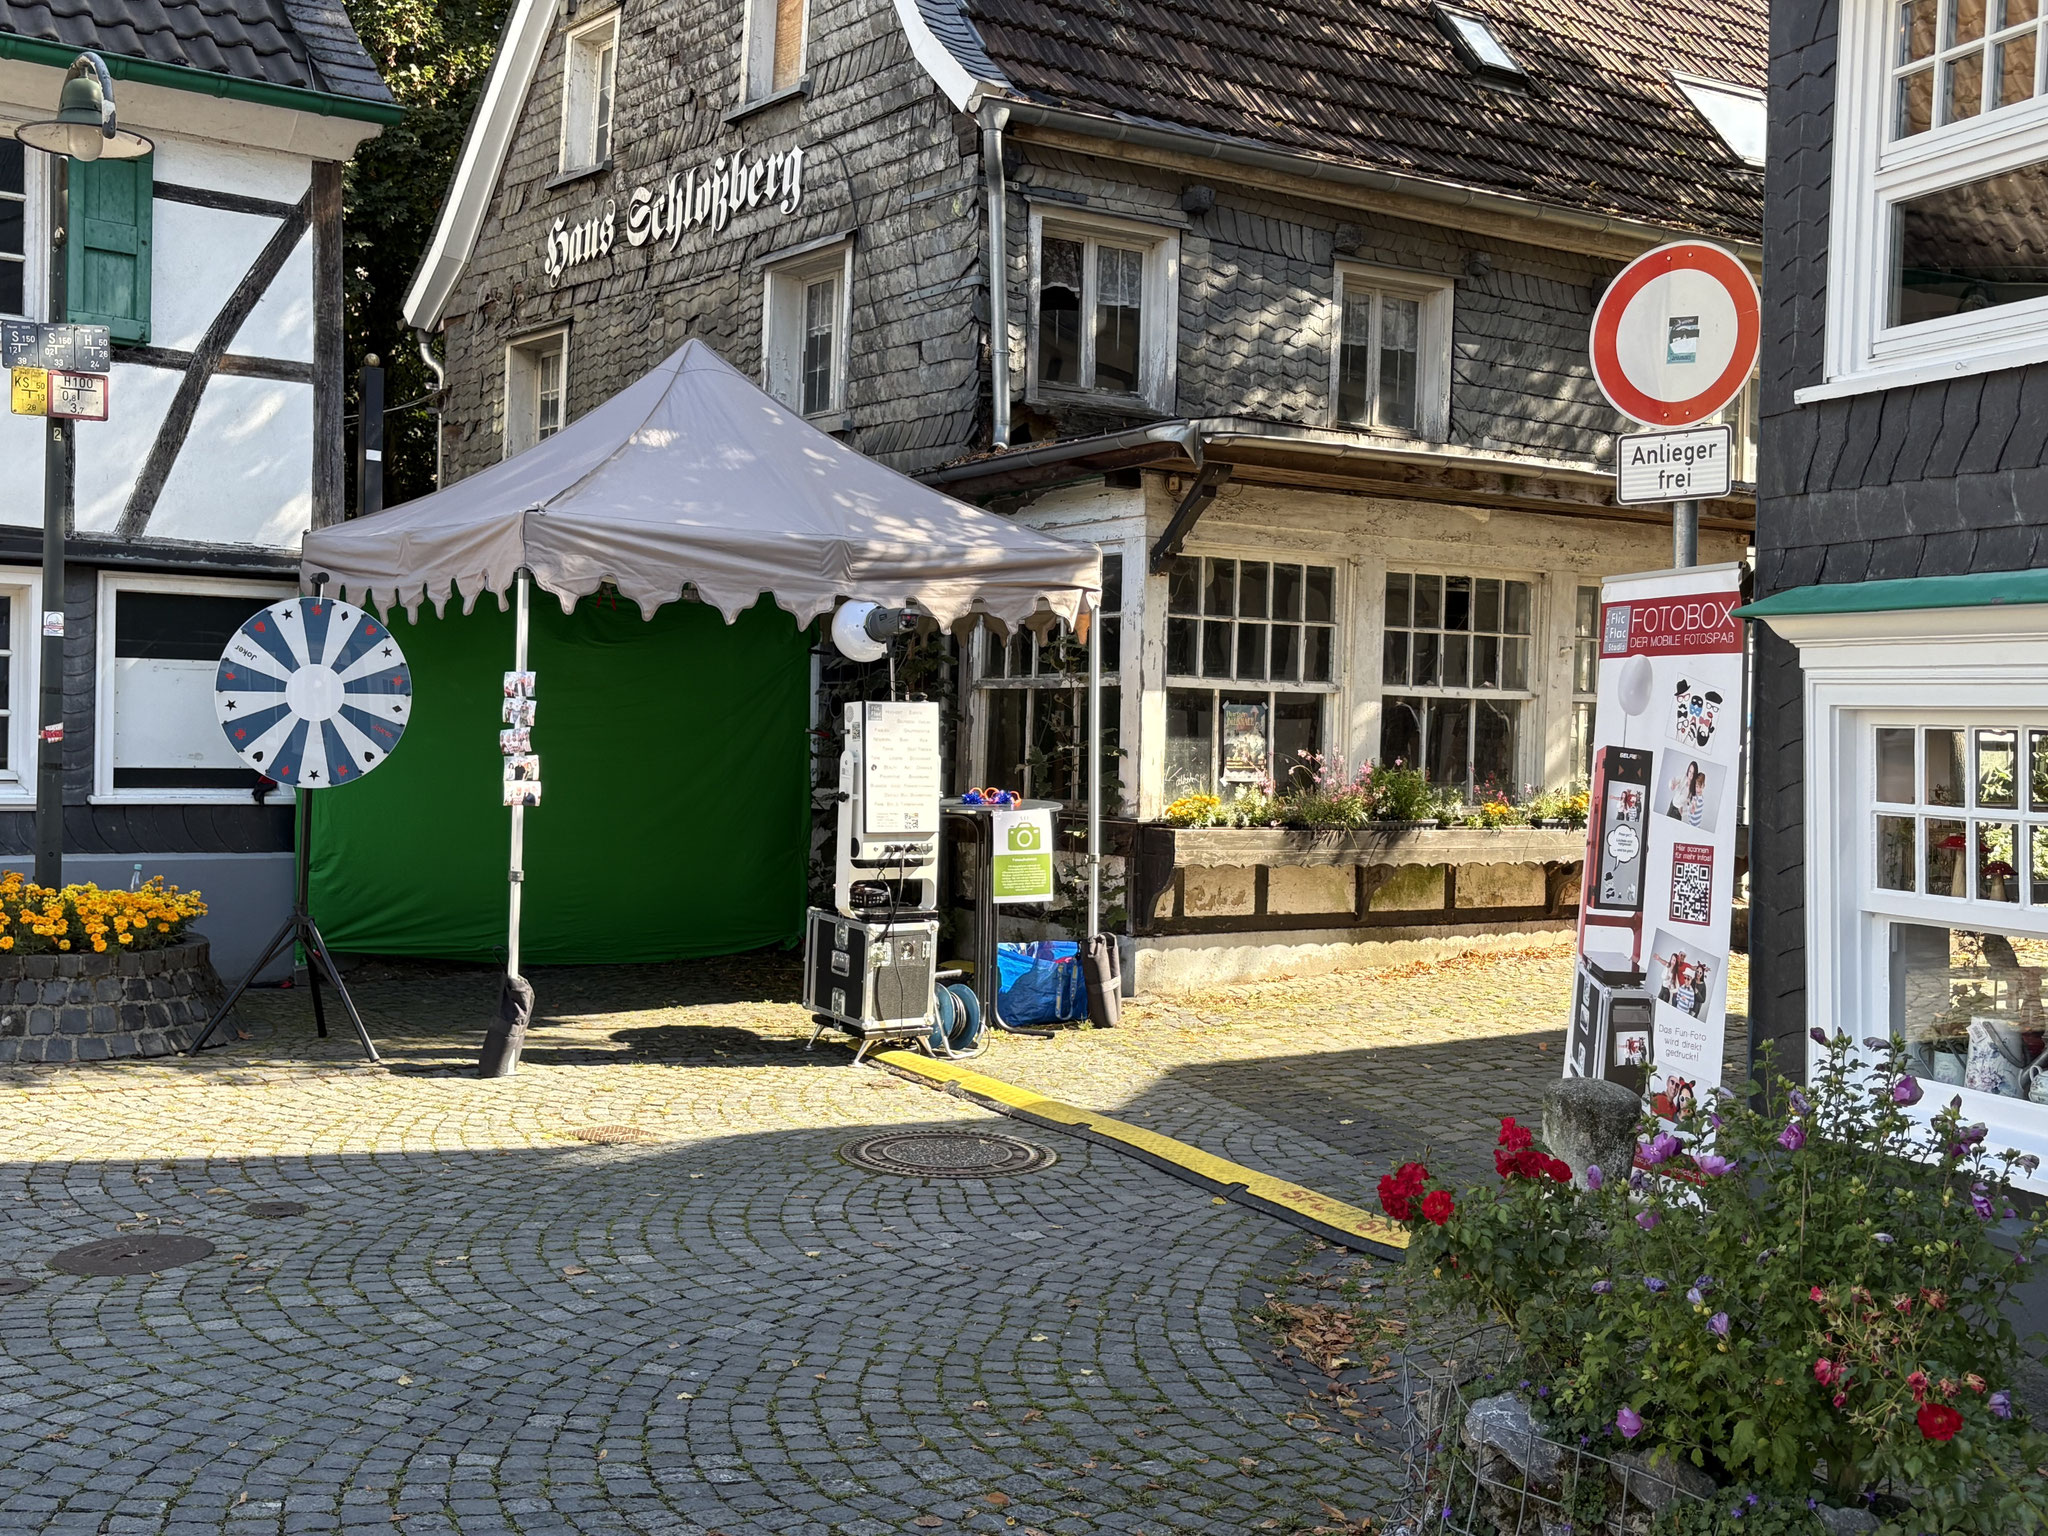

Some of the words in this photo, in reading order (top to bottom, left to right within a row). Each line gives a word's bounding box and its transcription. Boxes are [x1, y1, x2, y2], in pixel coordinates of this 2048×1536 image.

[544, 199, 616, 288] Haus
[627, 144, 804, 252] Schloßberg
[11, 330, 19, 342] S
[21, 335, 36, 343] 150
[48, 332, 56, 344] S
[84, 334, 92, 346] H
[14, 376, 30, 389] KS
[64, 376, 93, 389] H100
[54, 428, 61, 440] 2
[1631, 441, 1718, 467] Anlieger
[1657, 467, 1692, 490] frei
[1610, 611, 1626, 625] Flic
[1631, 600, 1736, 633] FOTOBOX
[1609, 627, 1627, 639] Flac
[1630, 636, 1648, 648] DER
[1650, 634, 1681, 647] MOBILE
[234, 645, 258, 661] Joker
[1658, 1023, 1673, 1035] Das
[1664, 1037, 1680, 1047] wird
[1681, 1040, 1702, 1052] direkt
